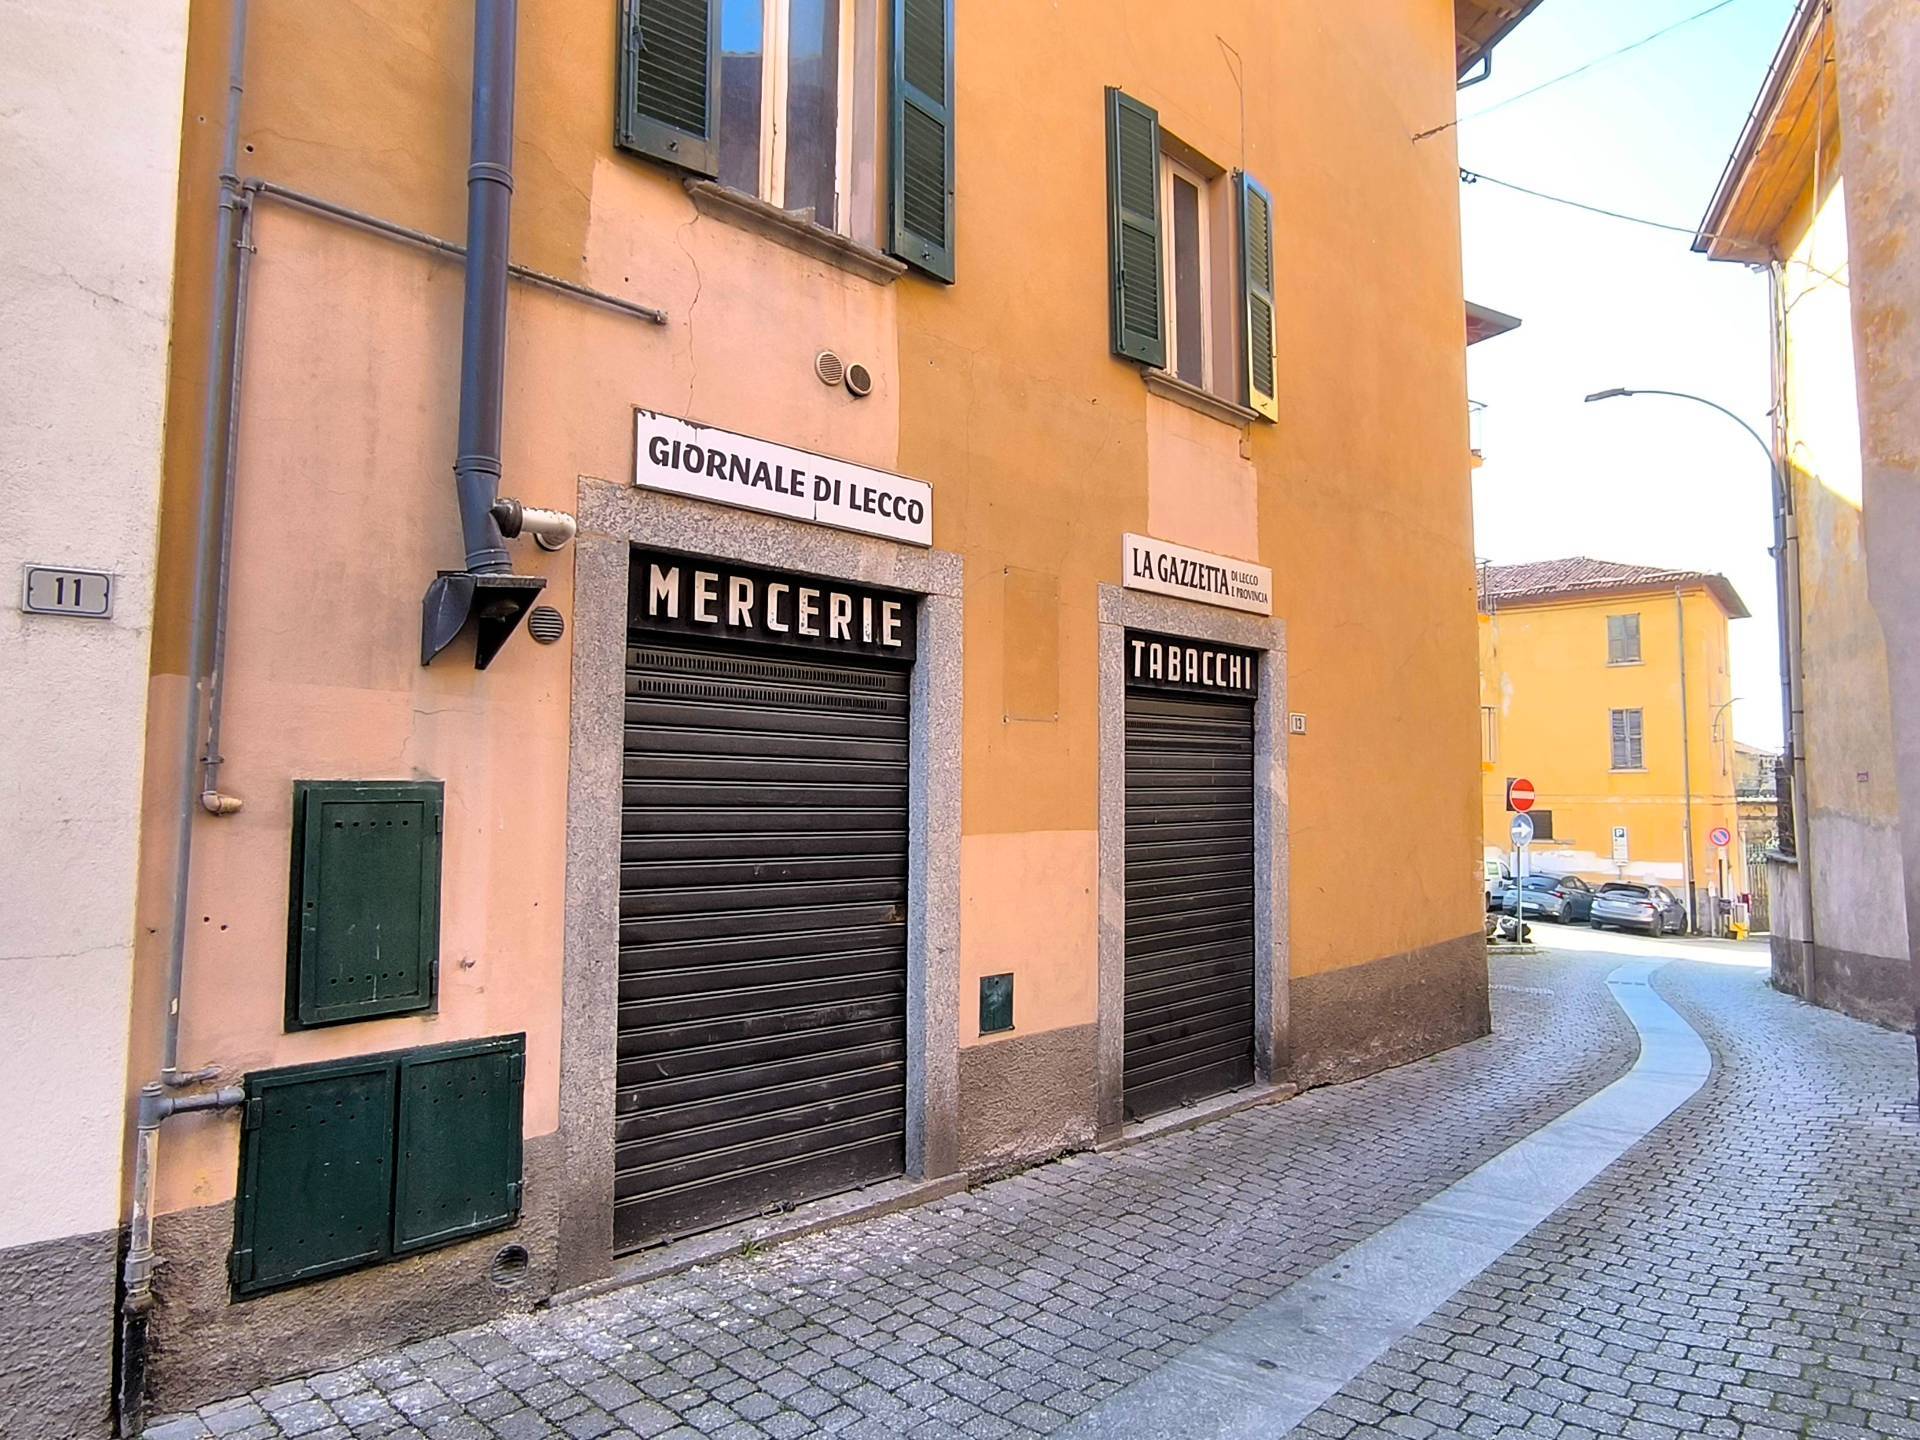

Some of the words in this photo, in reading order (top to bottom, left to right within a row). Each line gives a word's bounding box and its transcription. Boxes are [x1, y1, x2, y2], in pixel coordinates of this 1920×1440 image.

[648, 436, 806, 497] GIORNALE
[814, 475, 841, 505] DI
[850, 483, 924, 525] LECCO
[55, 577, 82, 607] 11
[1133, 547, 1154, 580] LA
[1157, 553, 1230, 596] GAZZETTA
[1231, 570, 1238, 582] DI
[1239, 571, 1259, 586] LECCO
[648, 563, 902, 647] MERCERIE
[1131, 640, 1251, 690] TABACCHI
[1294, 717, 1302, 730] 13
